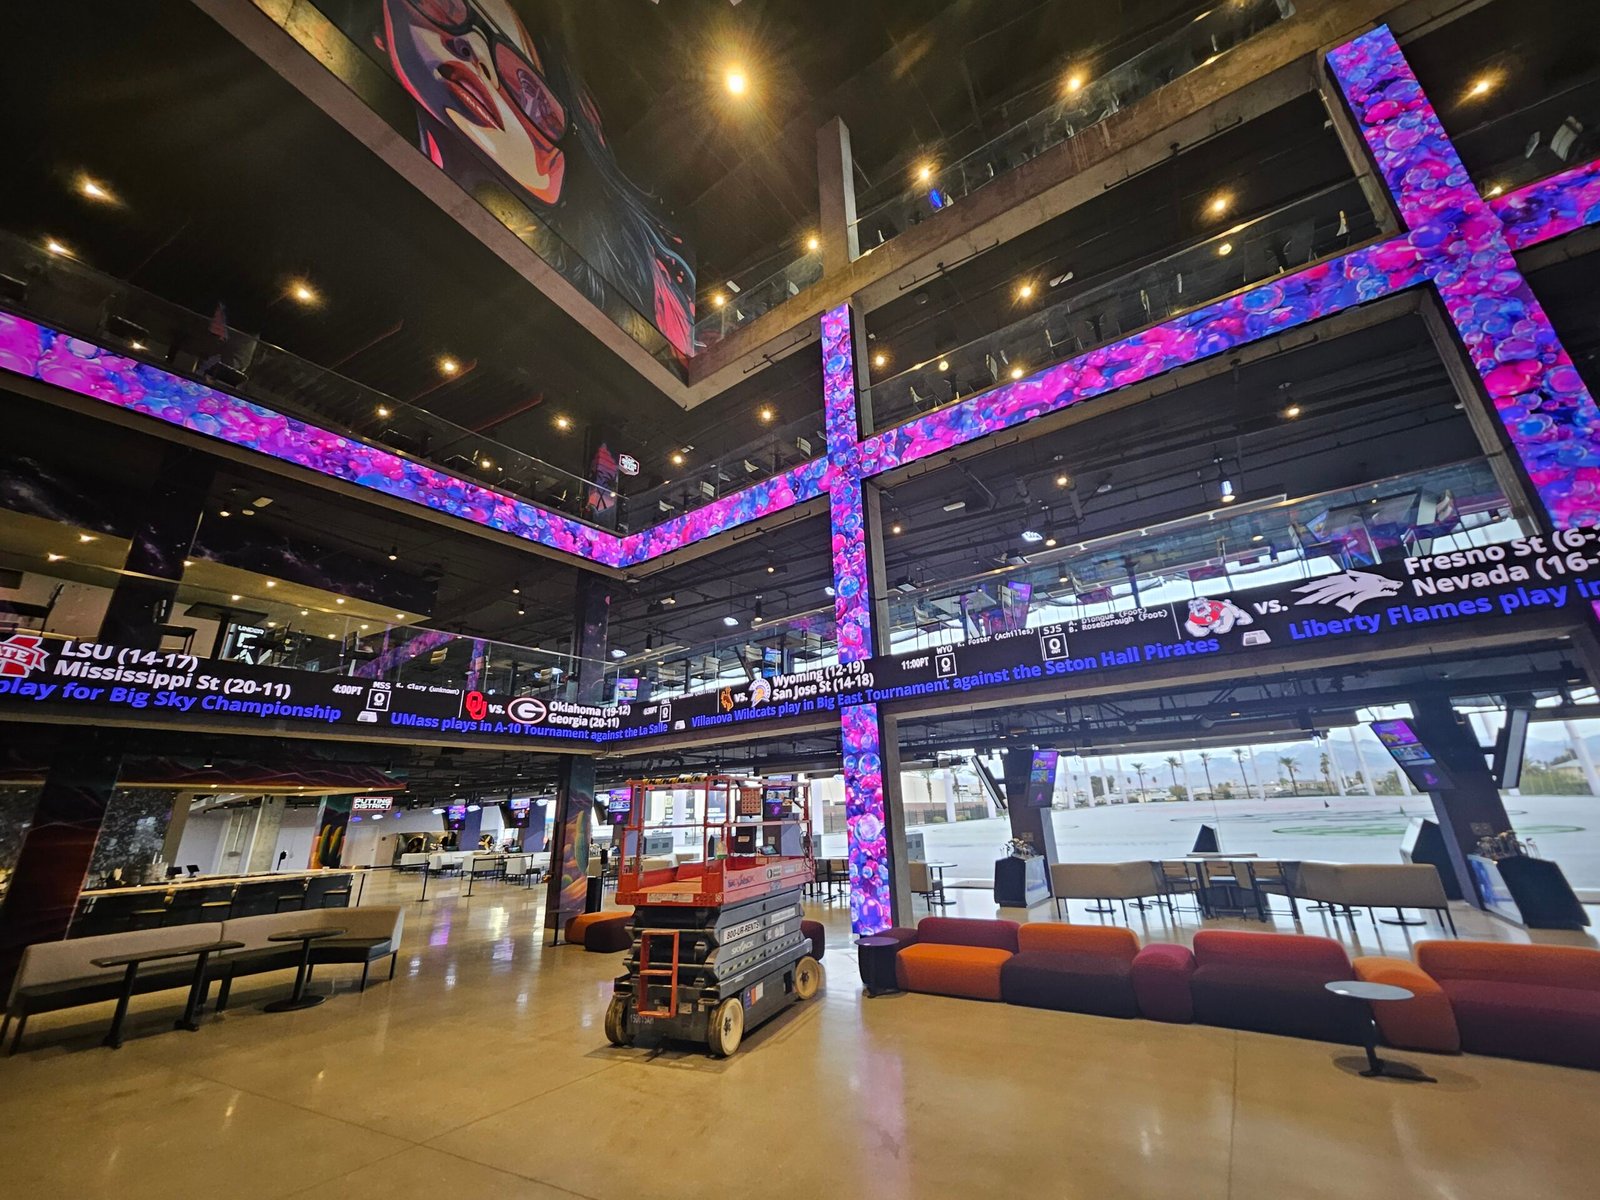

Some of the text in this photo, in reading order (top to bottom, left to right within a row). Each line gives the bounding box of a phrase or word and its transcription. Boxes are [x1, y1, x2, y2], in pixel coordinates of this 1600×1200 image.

[1404, 524, 1600, 575] Fresno St (6-
[1412, 551, 1600, 596] Nevada (16-
[1253, 600, 1288, 615] vs.
[1289, 614, 1380, 640] Liberty
[1387, 597, 1492, 625] Flames
[1498, 586, 1567, 614] play
[1081, 615, 1134, 631] Roseborough
[1138, 609, 1168, 622] (Foot)
[968, 635, 992, 645] Foster
[994, 628, 1034, 641] (Achilles)
[1043, 625, 1062, 635] SJS
[61, 640, 198, 672] LSU (14-17)
[936, 645, 953, 655] WYO
[901, 656, 929, 671] 11:00PT
[53, 660, 292, 700] Mississippi St (20-11)
[773, 660, 865, 688] Wyoming (12-19)
[332, 684, 363, 696] 4:00PT
[373, 681, 391, 690] MSS
[407, 683, 427, 692] Clary
[691, 638, 1220, 728] Villanova Wildcats play in Big East Tournament against the Seton Hall Pirates
[772, 673, 874, 701] San Jose St (14-18)
[62, 682, 104, 700] for
[110, 687, 150, 708] Big
[154, 691, 197, 711] Sky
[201, 695, 342, 722] Championship
[734, 692, 748, 702] vs.
[488, 704, 505, 714] vs.
[549, 701, 631, 718] Oklahoma (19-12)
[390, 712, 668, 742] UMass plays in A-10 Tournament against the La Salle
[548, 713, 620, 728] Georgia (20-11)
